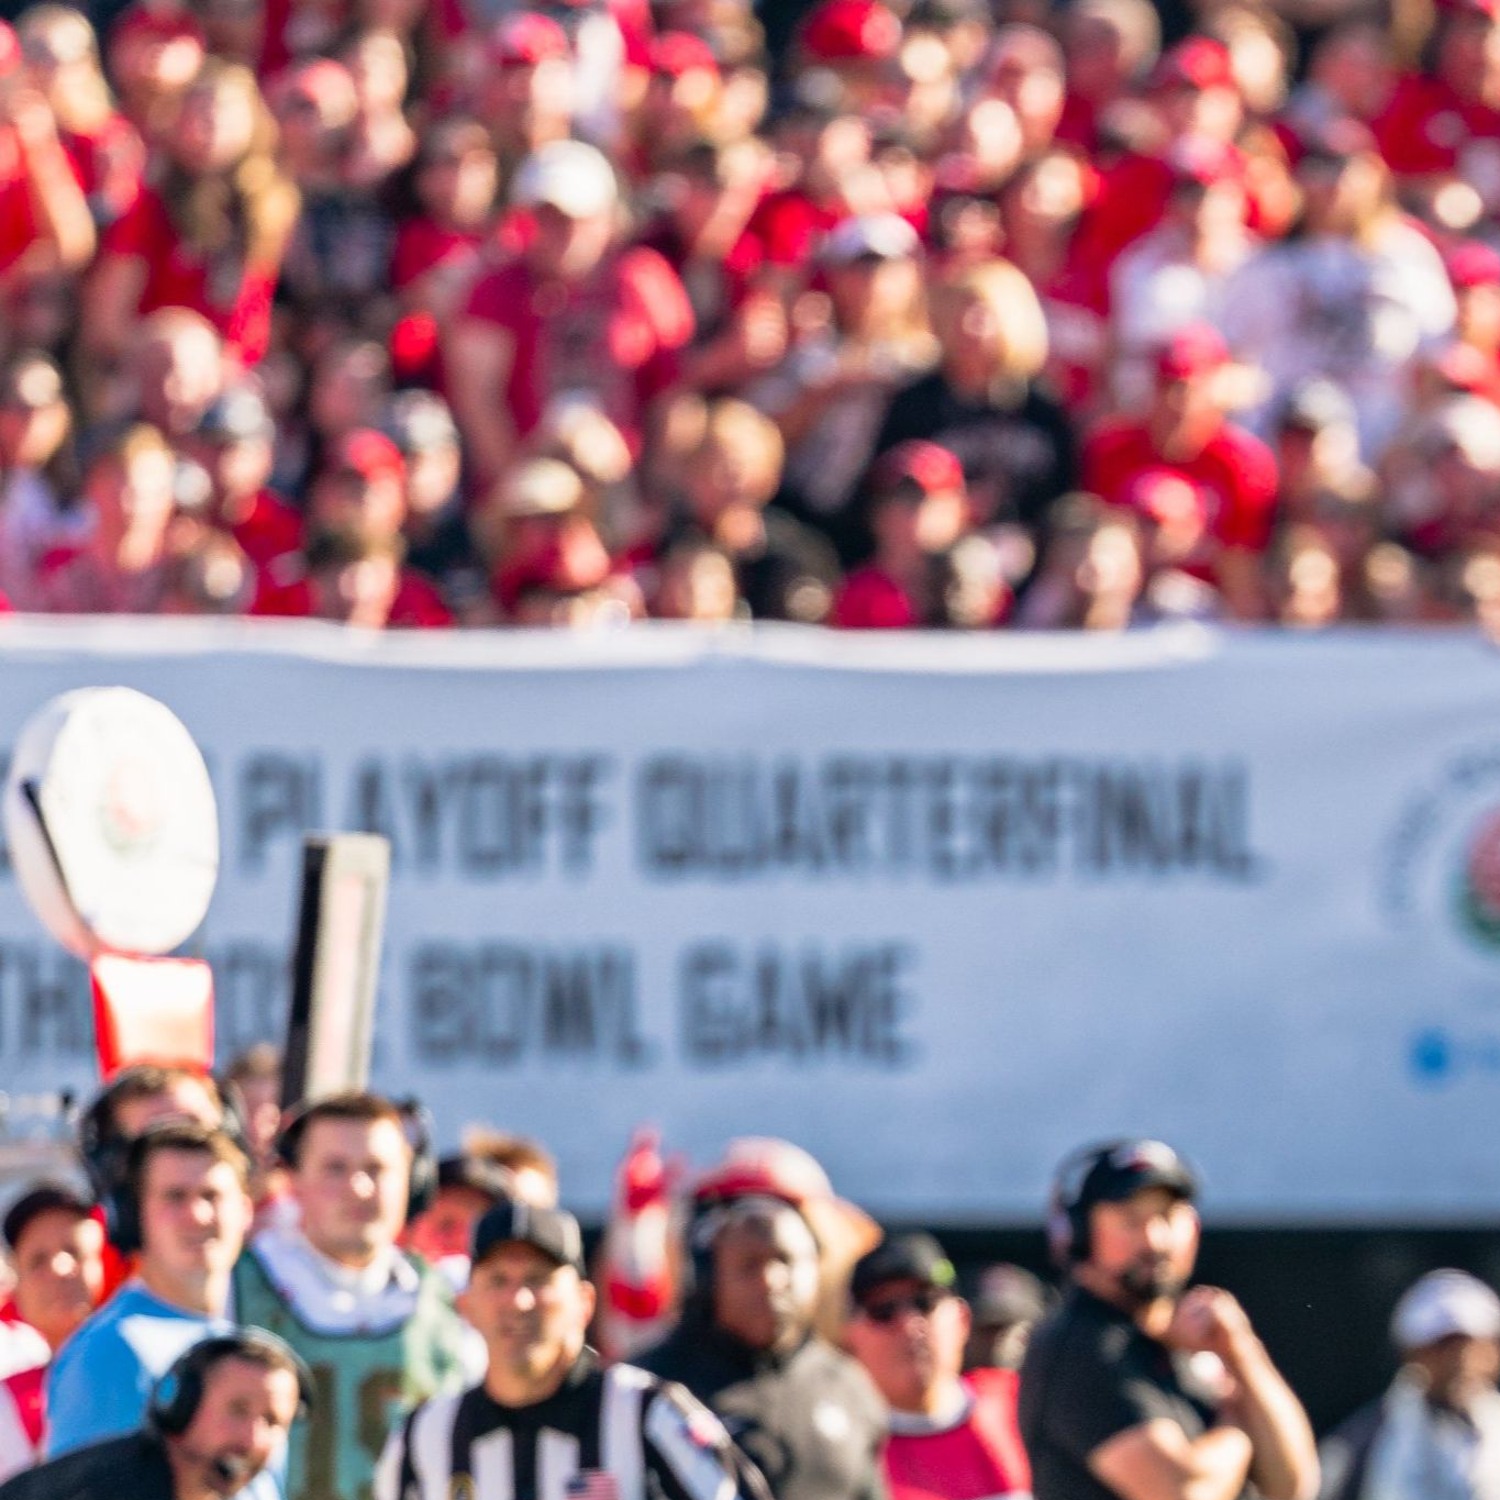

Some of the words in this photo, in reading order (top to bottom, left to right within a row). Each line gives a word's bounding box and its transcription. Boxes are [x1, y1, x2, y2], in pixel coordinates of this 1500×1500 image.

[640, 757, 1262, 880] QUARTERFINAL
[408, 942, 650, 1070] BOWL
[680, 942, 918, 1070] GAME
